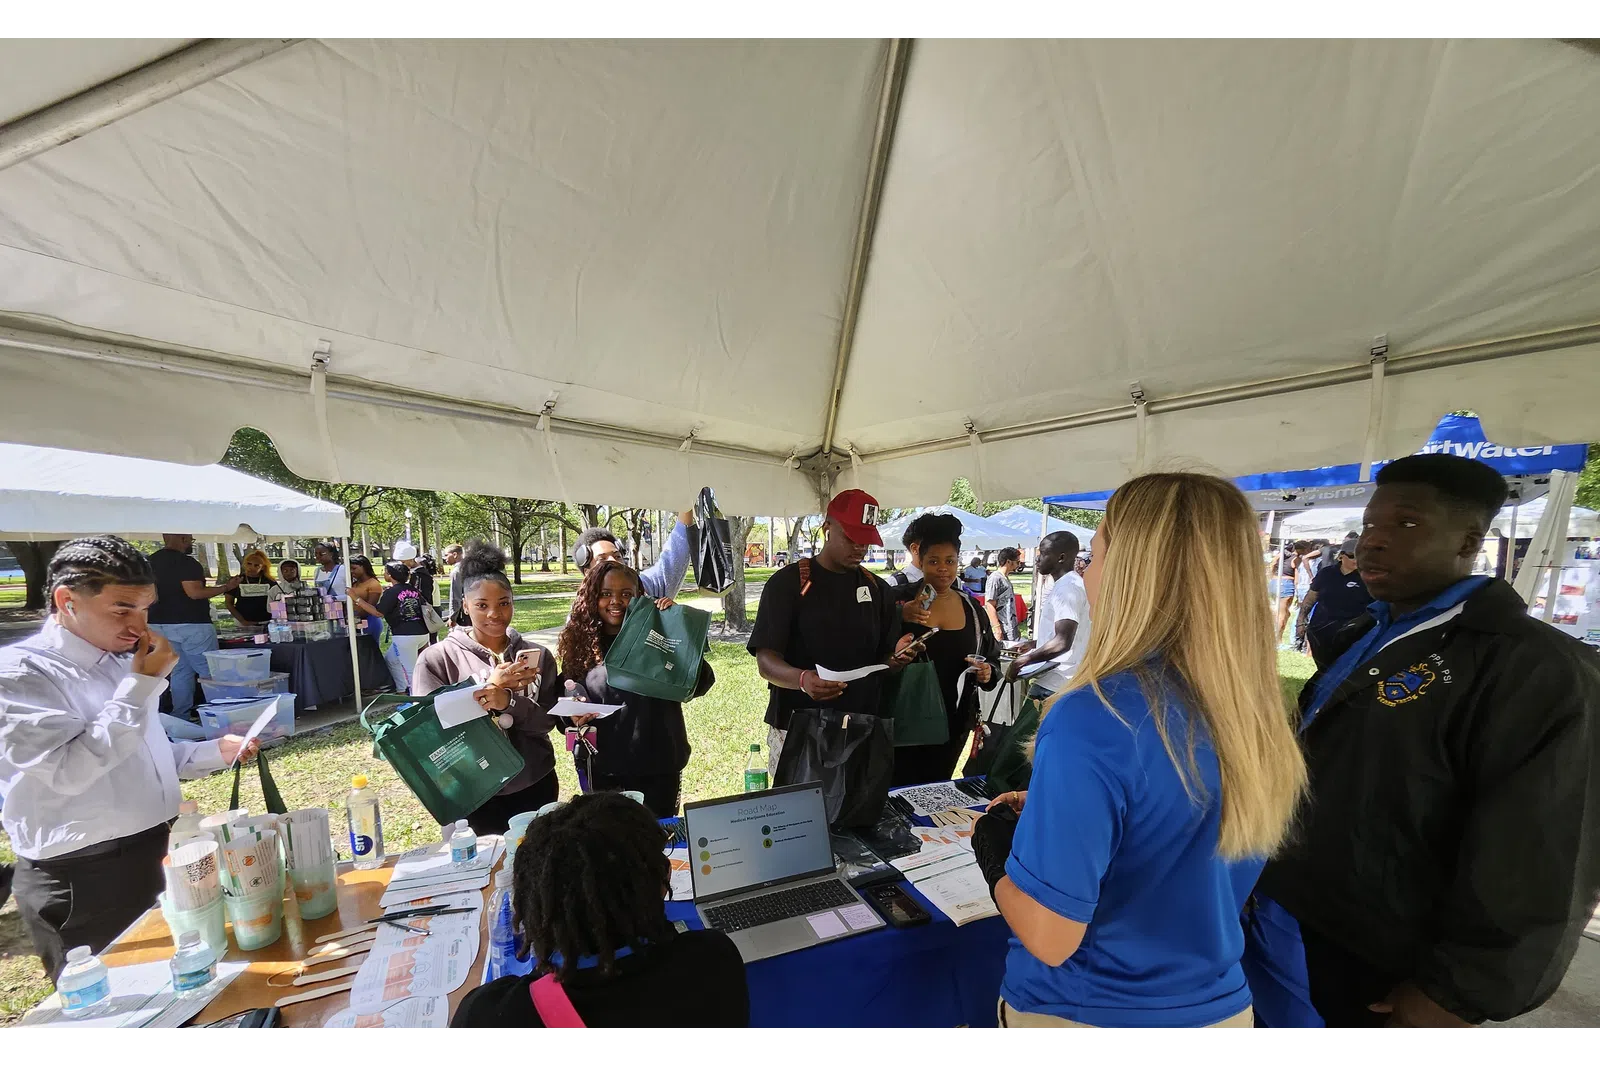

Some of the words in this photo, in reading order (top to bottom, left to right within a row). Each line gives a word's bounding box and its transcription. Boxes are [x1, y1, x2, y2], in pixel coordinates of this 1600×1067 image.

[1441, 668, 1453, 684] PSI
[737, 805, 759, 816] Road
[760, 803, 778, 812] Map
